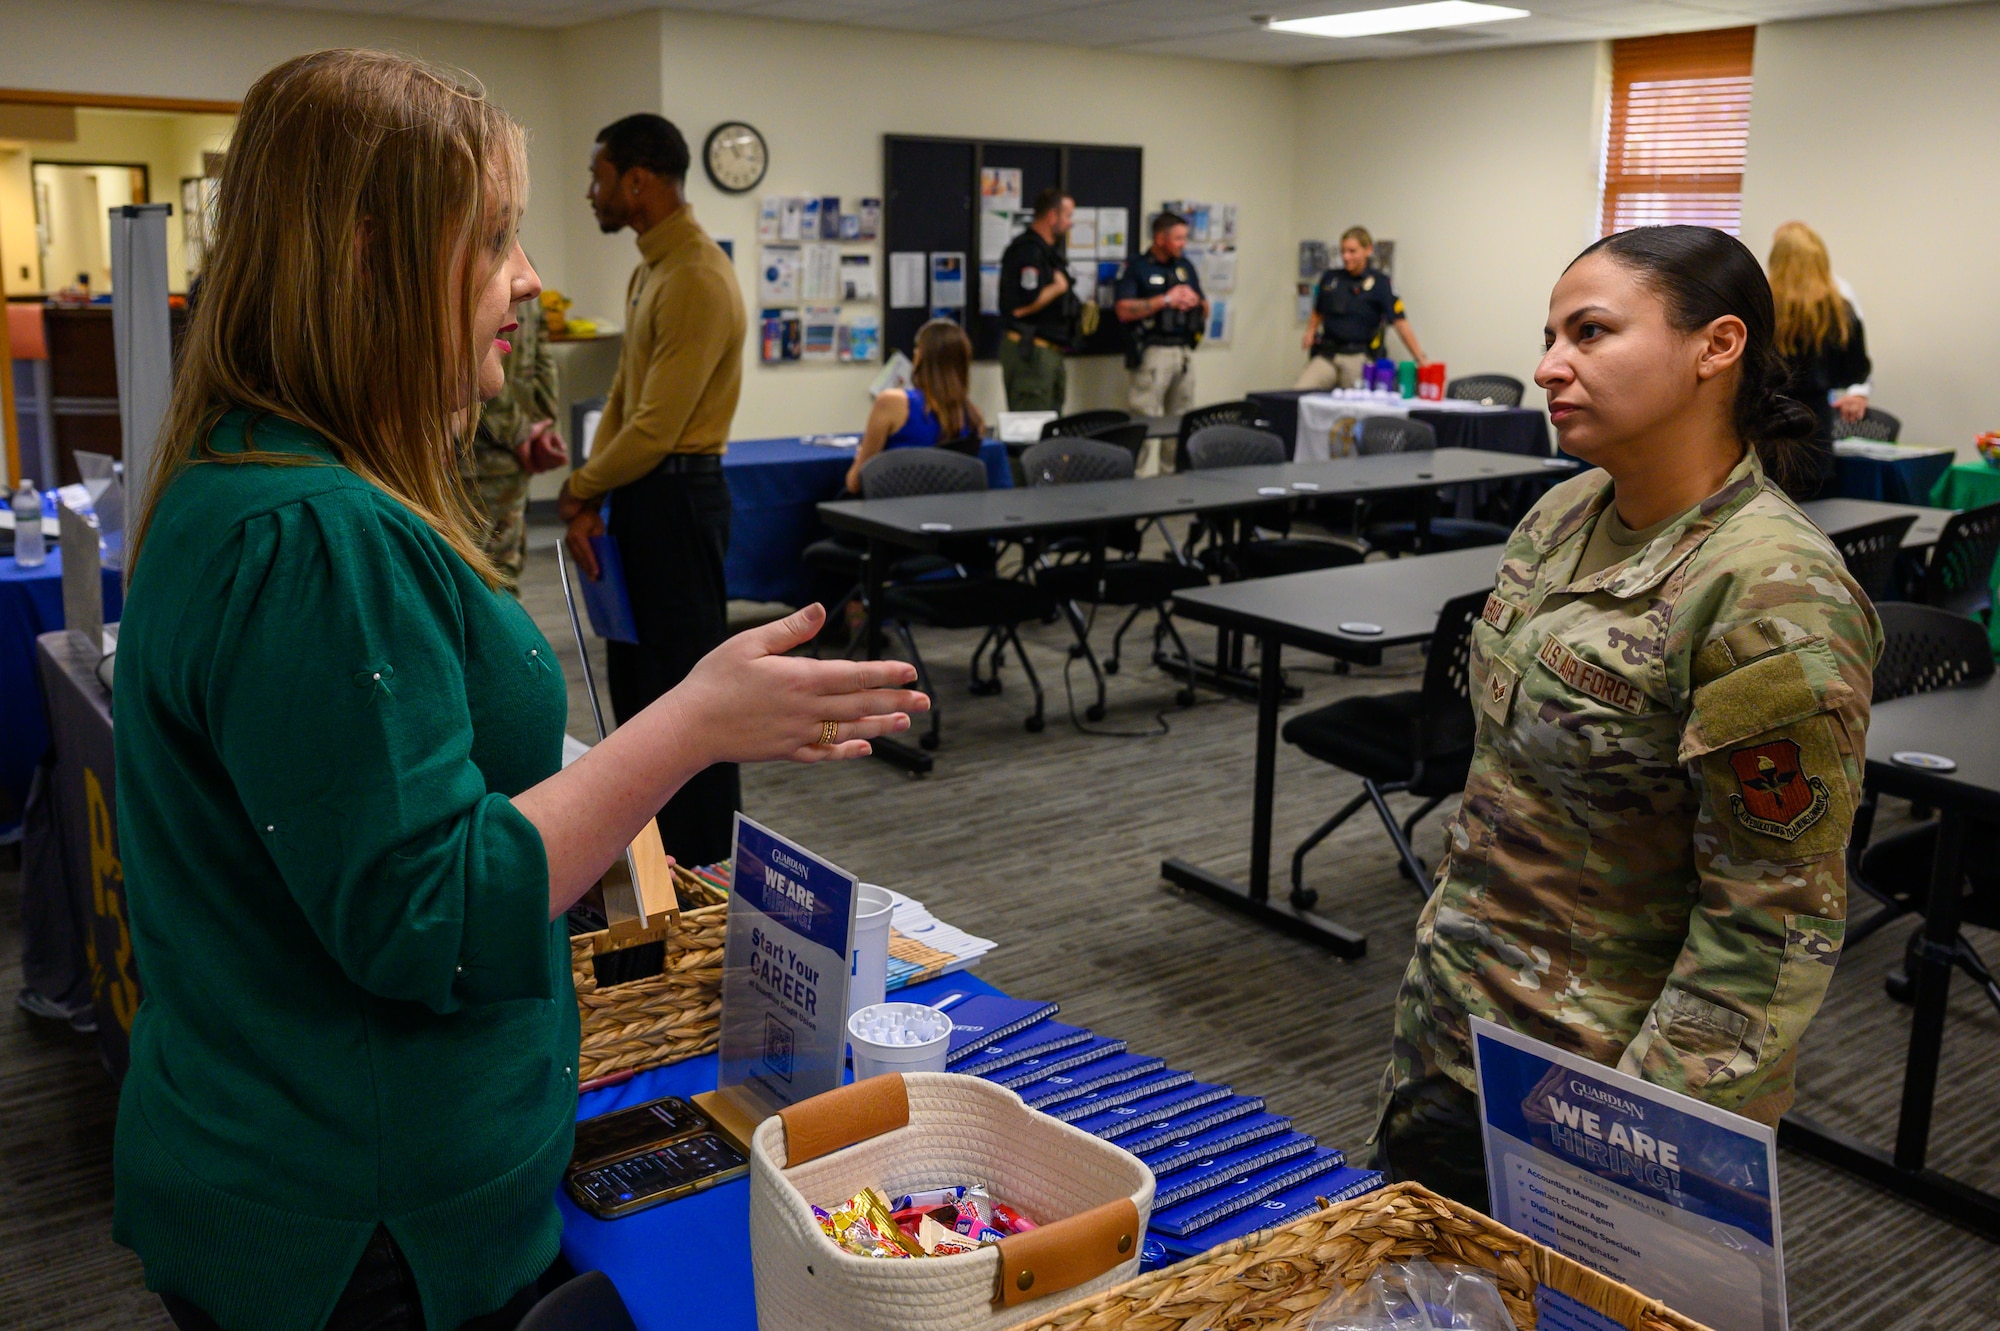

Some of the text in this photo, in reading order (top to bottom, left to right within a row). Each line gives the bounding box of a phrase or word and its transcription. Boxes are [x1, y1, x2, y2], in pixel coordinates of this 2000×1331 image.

[1541, 638, 1640, 709] U.S. AIR FORCE
[772, 848, 809, 880] GUARDIAN
[762, 884, 813, 931] HIRING!
[765, 865, 786, 894] WE
[786, 880, 815, 912] ARE
[752, 927, 784, 964] Start
[788, 949, 819, 986] Your
[750, 951, 817, 1016] CAREER
[1570, 1080, 1644, 1120] GUARDIAN
[1547, 1095, 1680, 1172] WE ARE
[1550, 1121, 1681, 1198] HIRING!
[1527, 1168, 1609, 1210] Accounting Manager
[1529, 1184, 1615, 1229] Contact Center Agent
[1578, 1174, 1620, 1197] POSITIONS
[1530, 1200, 1641, 1258] Digital Marketing Specialist
[1532, 1216, 1620, 1264] Home Loan Originator
[1558, 1244, 1578, 1260] Loan
[1579, 1254, 1599, 1270] Post
[1599, 1265, 1627, 1283] Closer
